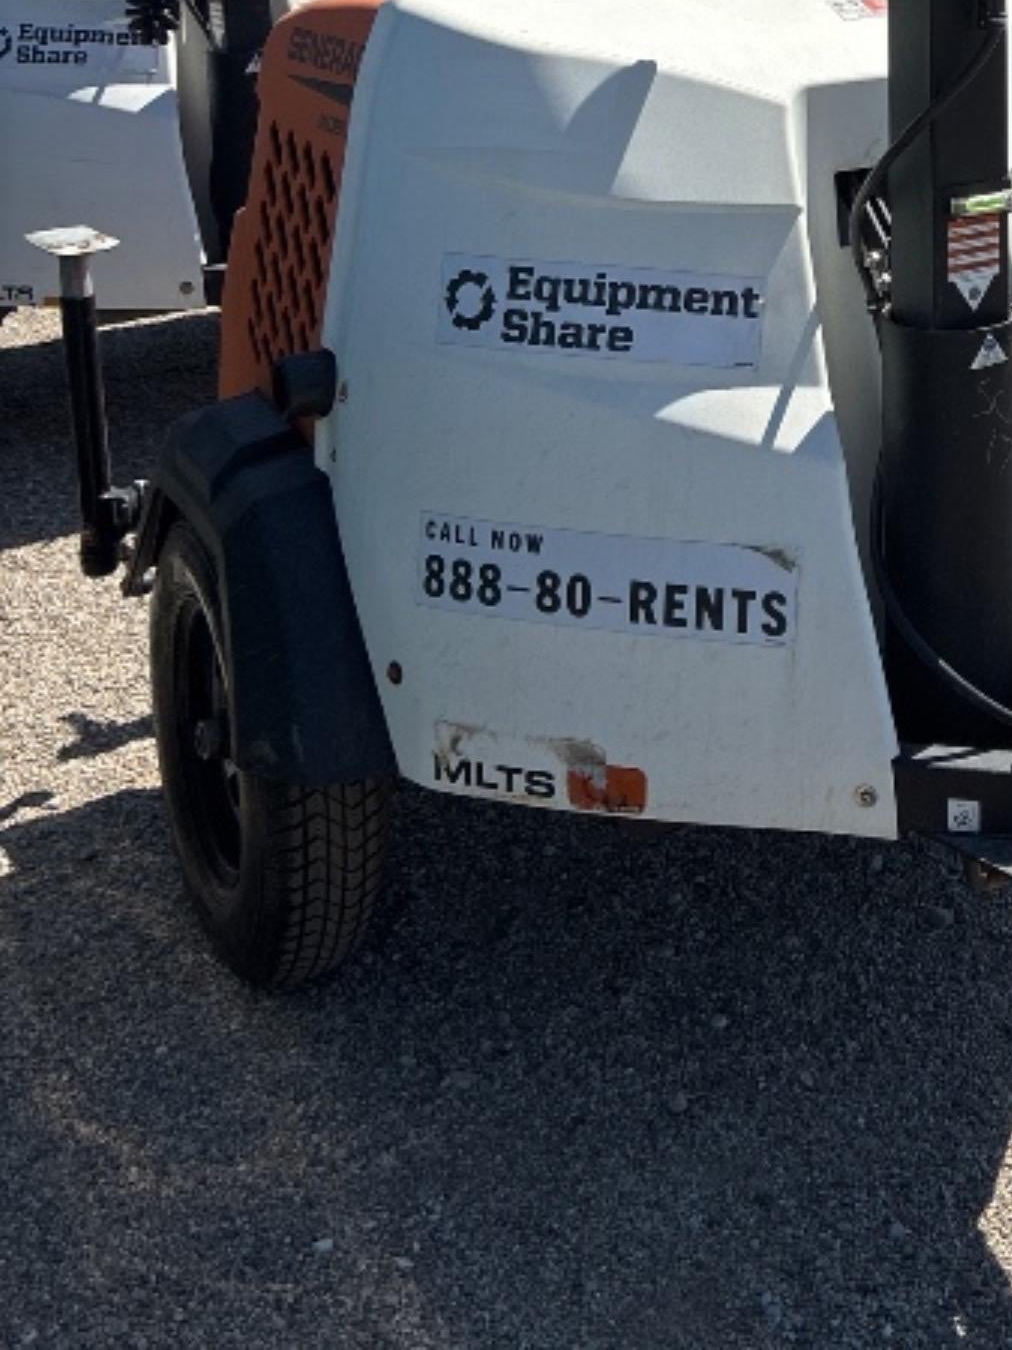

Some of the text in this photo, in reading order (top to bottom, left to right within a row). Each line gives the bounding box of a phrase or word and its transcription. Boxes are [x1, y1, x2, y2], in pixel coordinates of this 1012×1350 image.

[17, 44, 88, 66] Share
[506, 266, 761, 319] Equipment
[501, 308, 634, 352] Share
[425, 520, 544, 555] CALL NOW
[423, 553, 788, 637] 888-80-RENTS
[433, 751, 556, 798] MLTS
